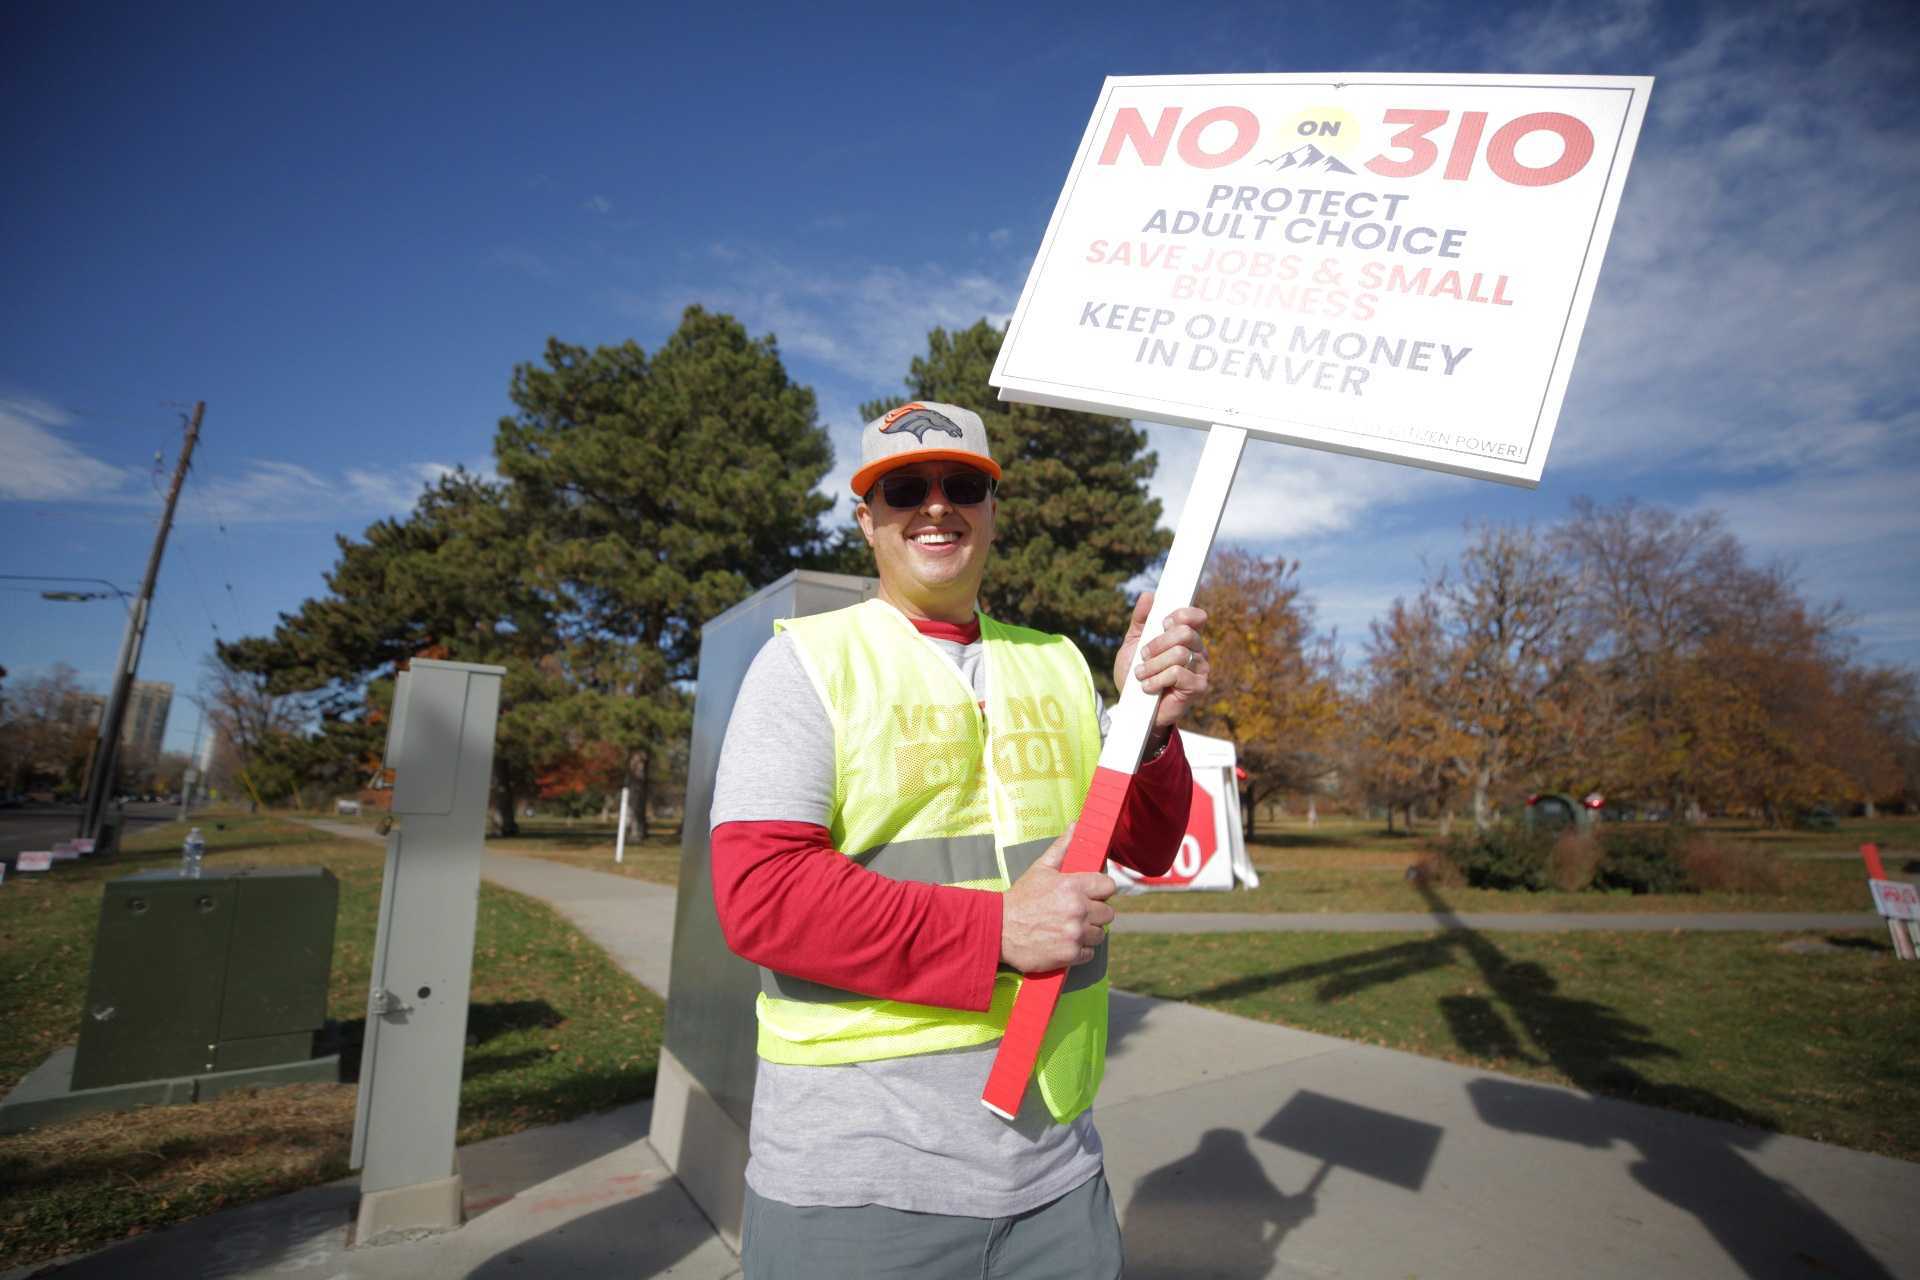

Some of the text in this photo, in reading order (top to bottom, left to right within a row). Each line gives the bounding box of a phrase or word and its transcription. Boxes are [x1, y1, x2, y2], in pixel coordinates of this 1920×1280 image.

[1097, 106, 1595, 187] NO ON 310
[1206, 184, 1409, 221] PROTECT
[1142, 209, 1466, 259] ADULT CHOICE
[1085, 240, 1513, 306] SAVE JOBS & SMALL
[1171, 275, 1379, 321] BUSINESS
[1079, 301, 1472, 376] KEEP OUR MONEY
[1136, 338, 1370, 397] IN DENVER
[1456, 435, 1523, 457] POWER!
[1007, 696, 1065, 730] NO
